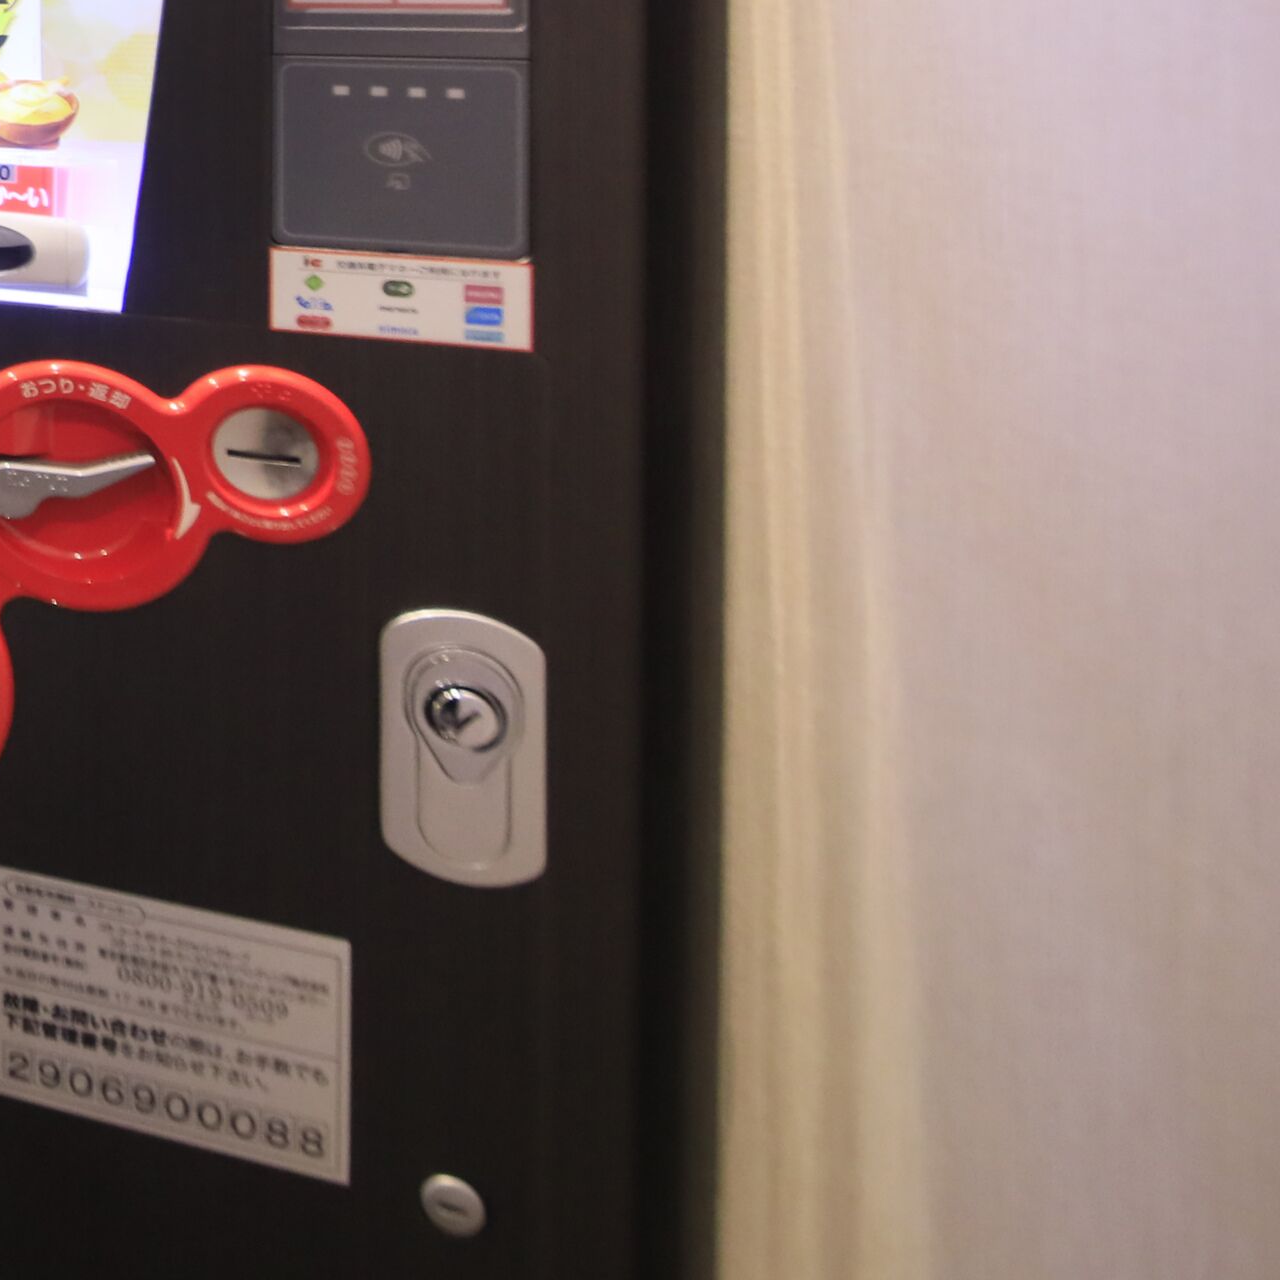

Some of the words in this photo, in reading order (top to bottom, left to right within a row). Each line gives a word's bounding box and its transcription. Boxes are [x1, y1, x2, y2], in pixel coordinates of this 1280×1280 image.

[19, 377, 132, 410] おつり・返却
[7, 1050, 326, 1159] 2906900088
